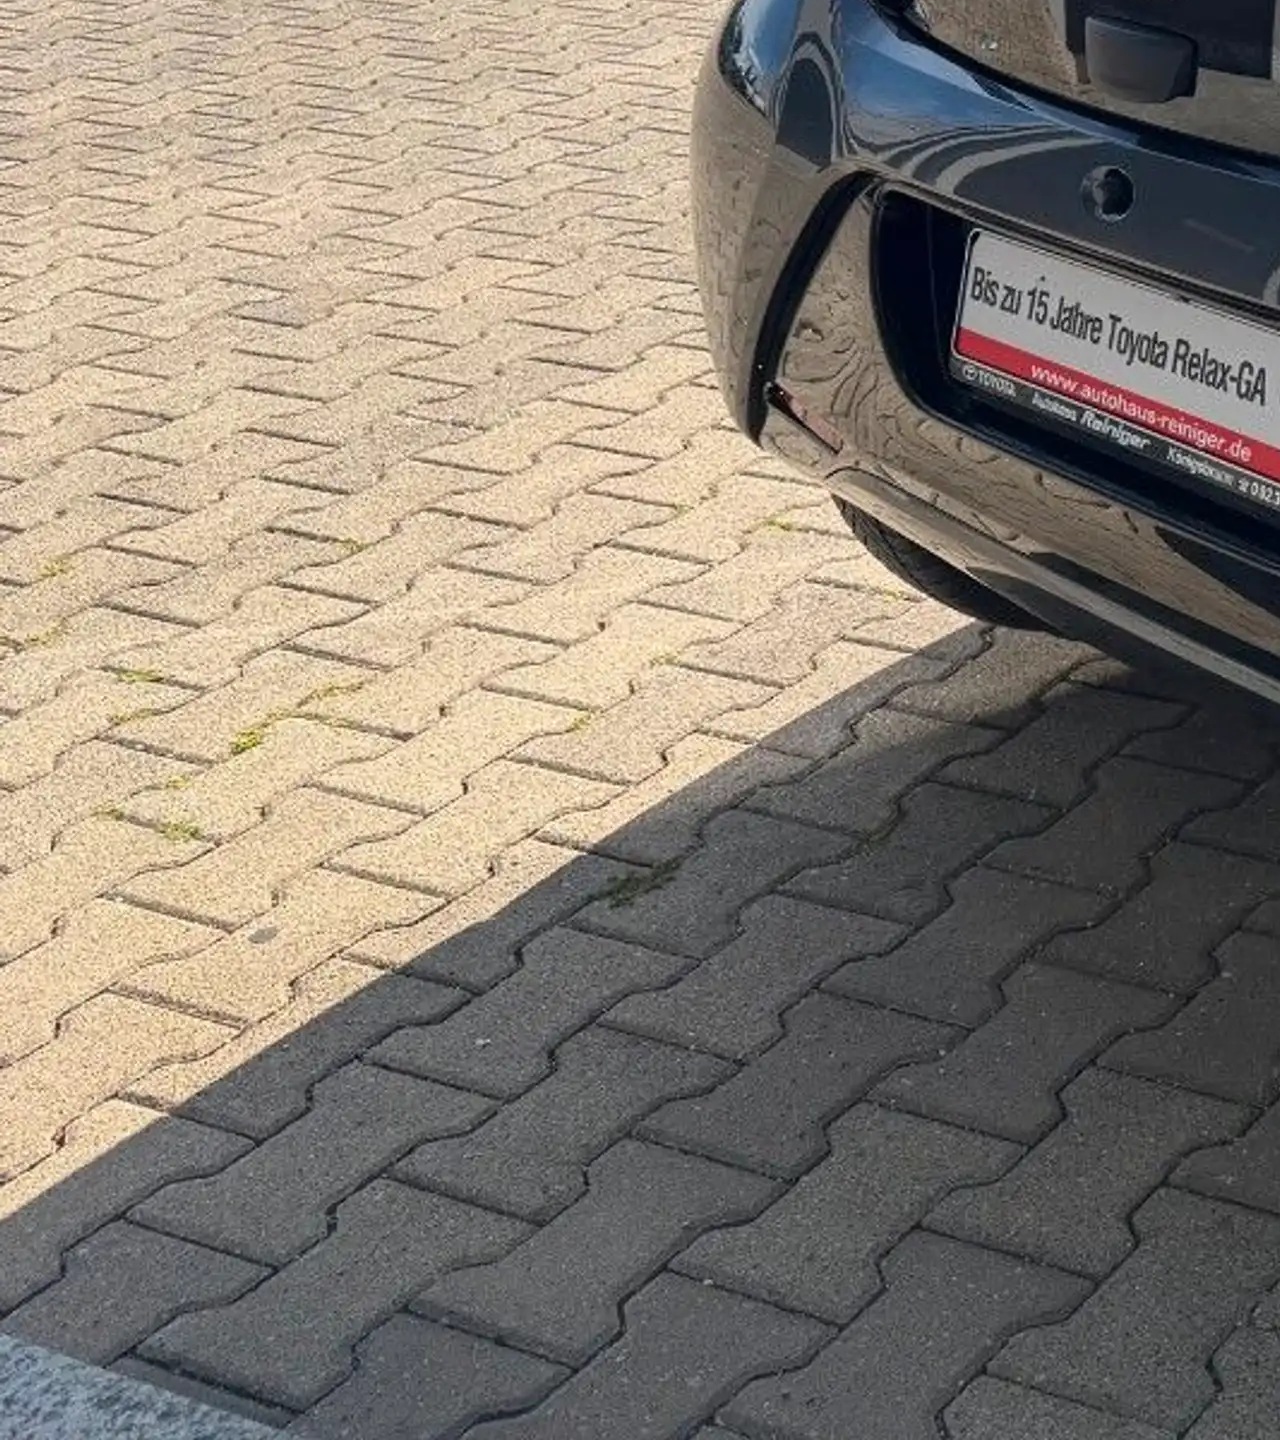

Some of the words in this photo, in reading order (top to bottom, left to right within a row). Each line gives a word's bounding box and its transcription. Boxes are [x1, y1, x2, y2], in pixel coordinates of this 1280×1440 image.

[970, 266, 999, 307] Bis
[1000, 285, 1022, 315] zu
[1027, 286, 1050, 325] 15
[1050, 295, 1103, 345] Jahre
[1109, 313, 1169, 366] Toyota
[1171, 320, 1267, 407] Relax-GA
[1031, 363, 1252, 462] www.autohaus-reiniger.de
[1080, 408, 1152, 450] Reiniger
